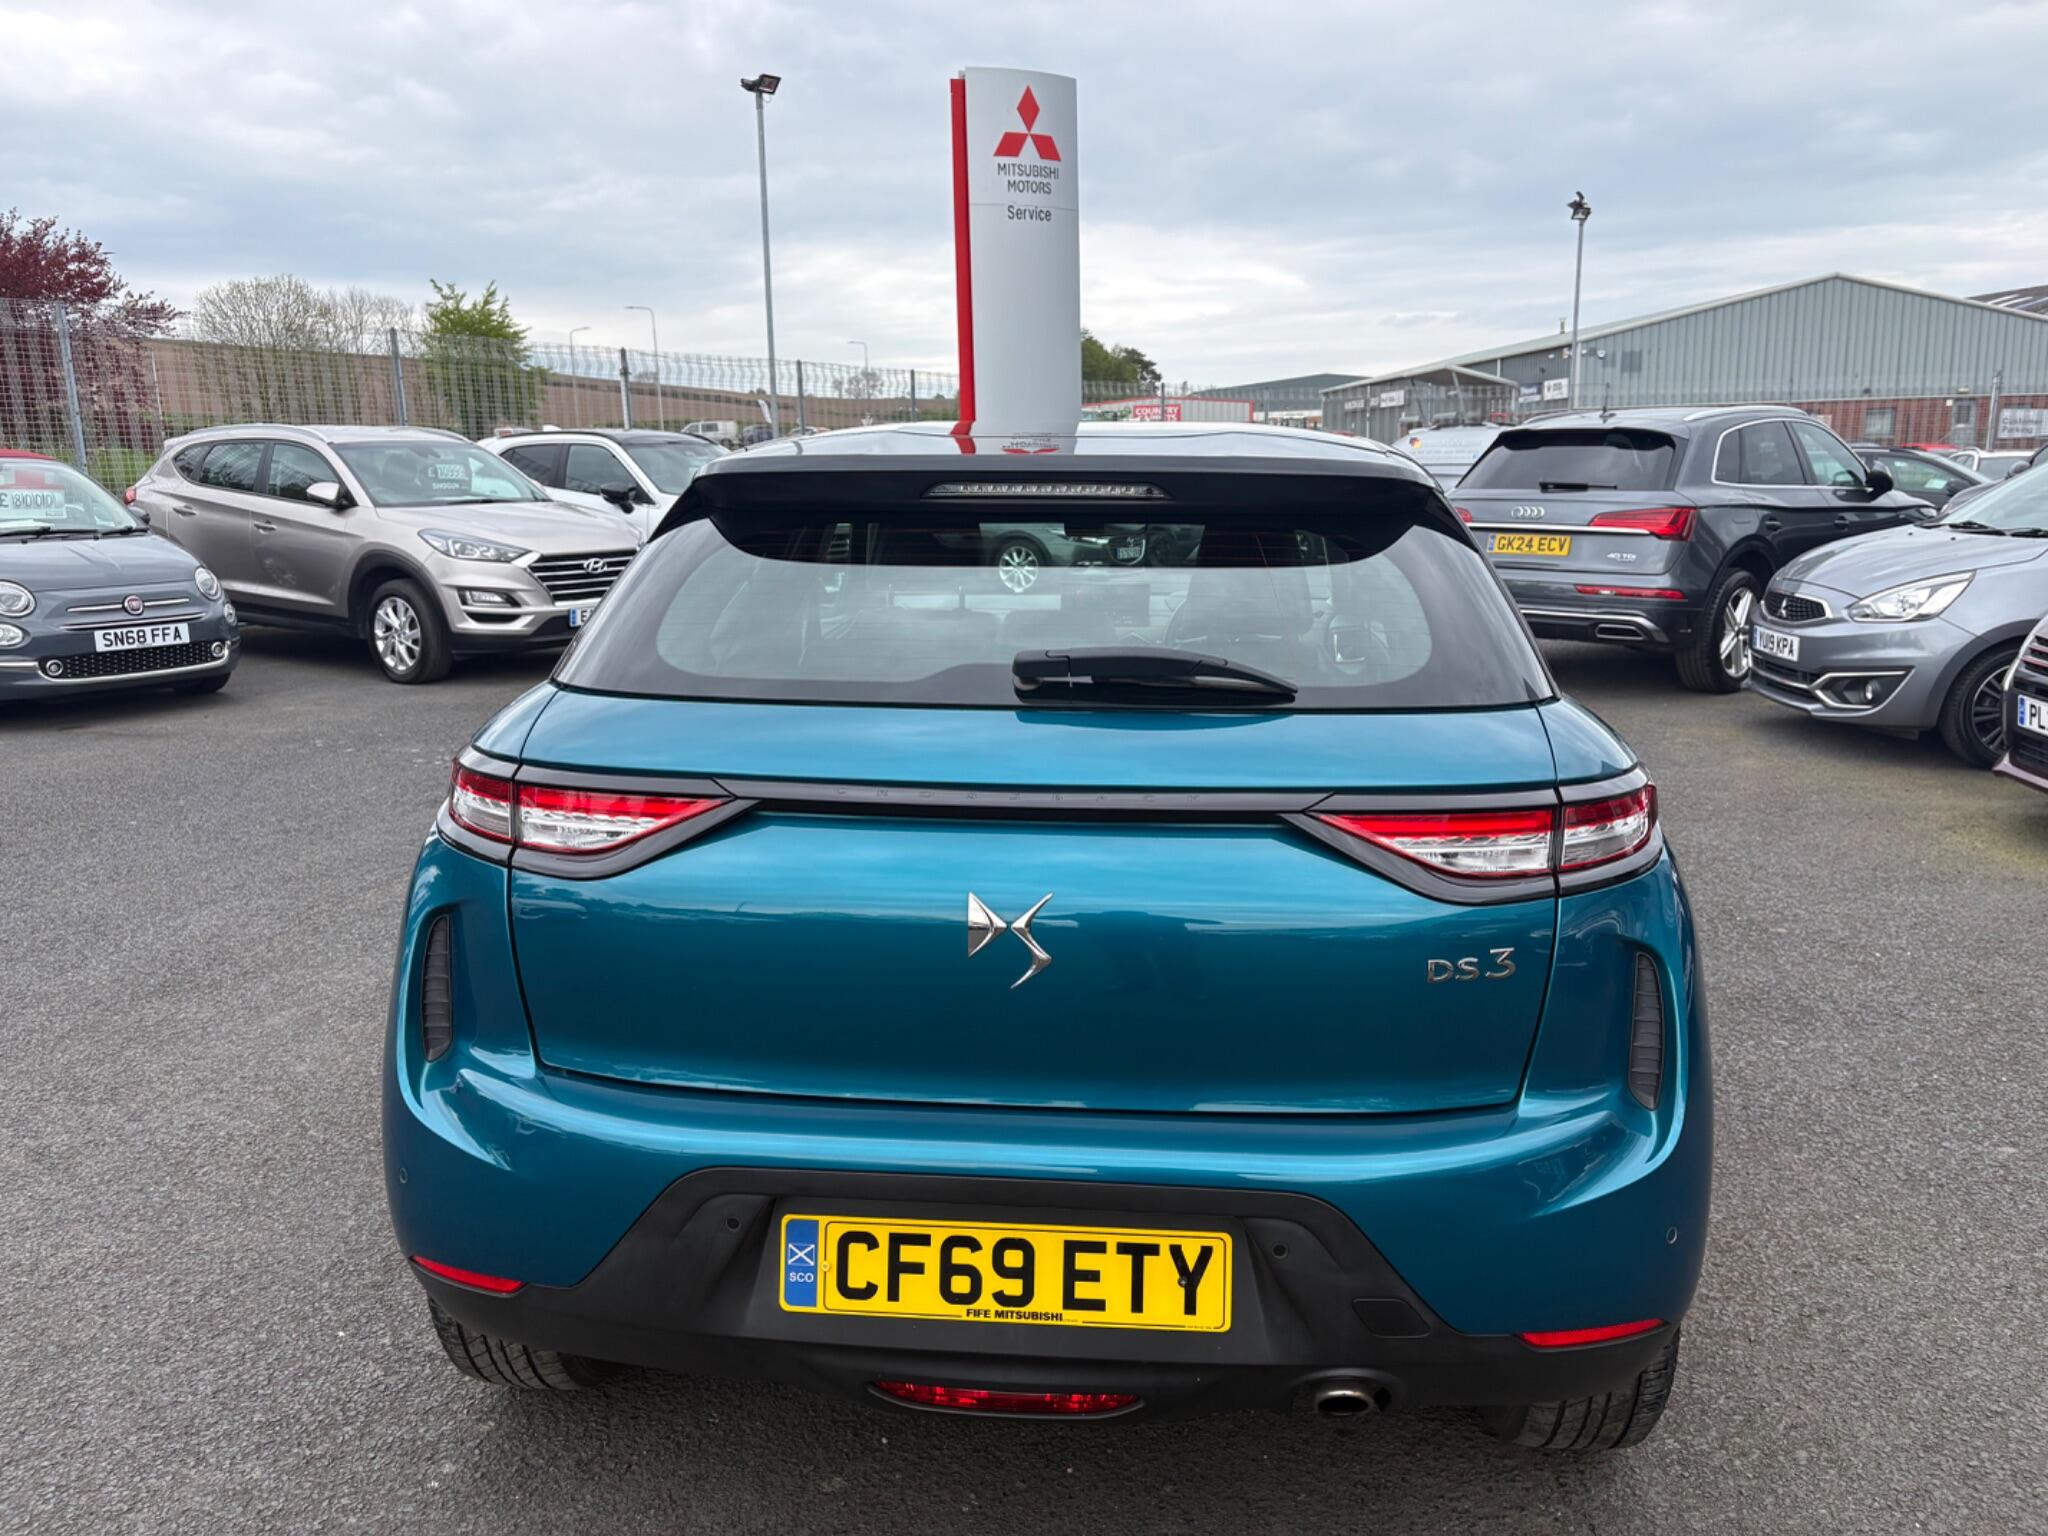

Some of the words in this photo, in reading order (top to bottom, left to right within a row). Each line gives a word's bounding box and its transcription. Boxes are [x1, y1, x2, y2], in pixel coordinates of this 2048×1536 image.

[997, 162, 1060, 180] MITSUBISHI
[1007, 179, 1052, 195] MOTORS
[1007, 204, 1052, 222] Service
[1135, 406, 1179, 416] COUNRY
[1496, 535, 1534, 551] GK24
[1537, 536, 1568, 553] ECV
[102, 629, 147, 648] SN68
[150, 626, 183, 643] FFA
[1776, 636, 1795, 657] KPA
[789, 1272, 814, 1283] SCO
[836, 1230, 1035, 1308] CF69
[1062, 1239, 1214, 1316] ETY
[966, 1308, 992, 1319] FIFE
[994, 1309, 1063, 1321] MITSUBISHI
